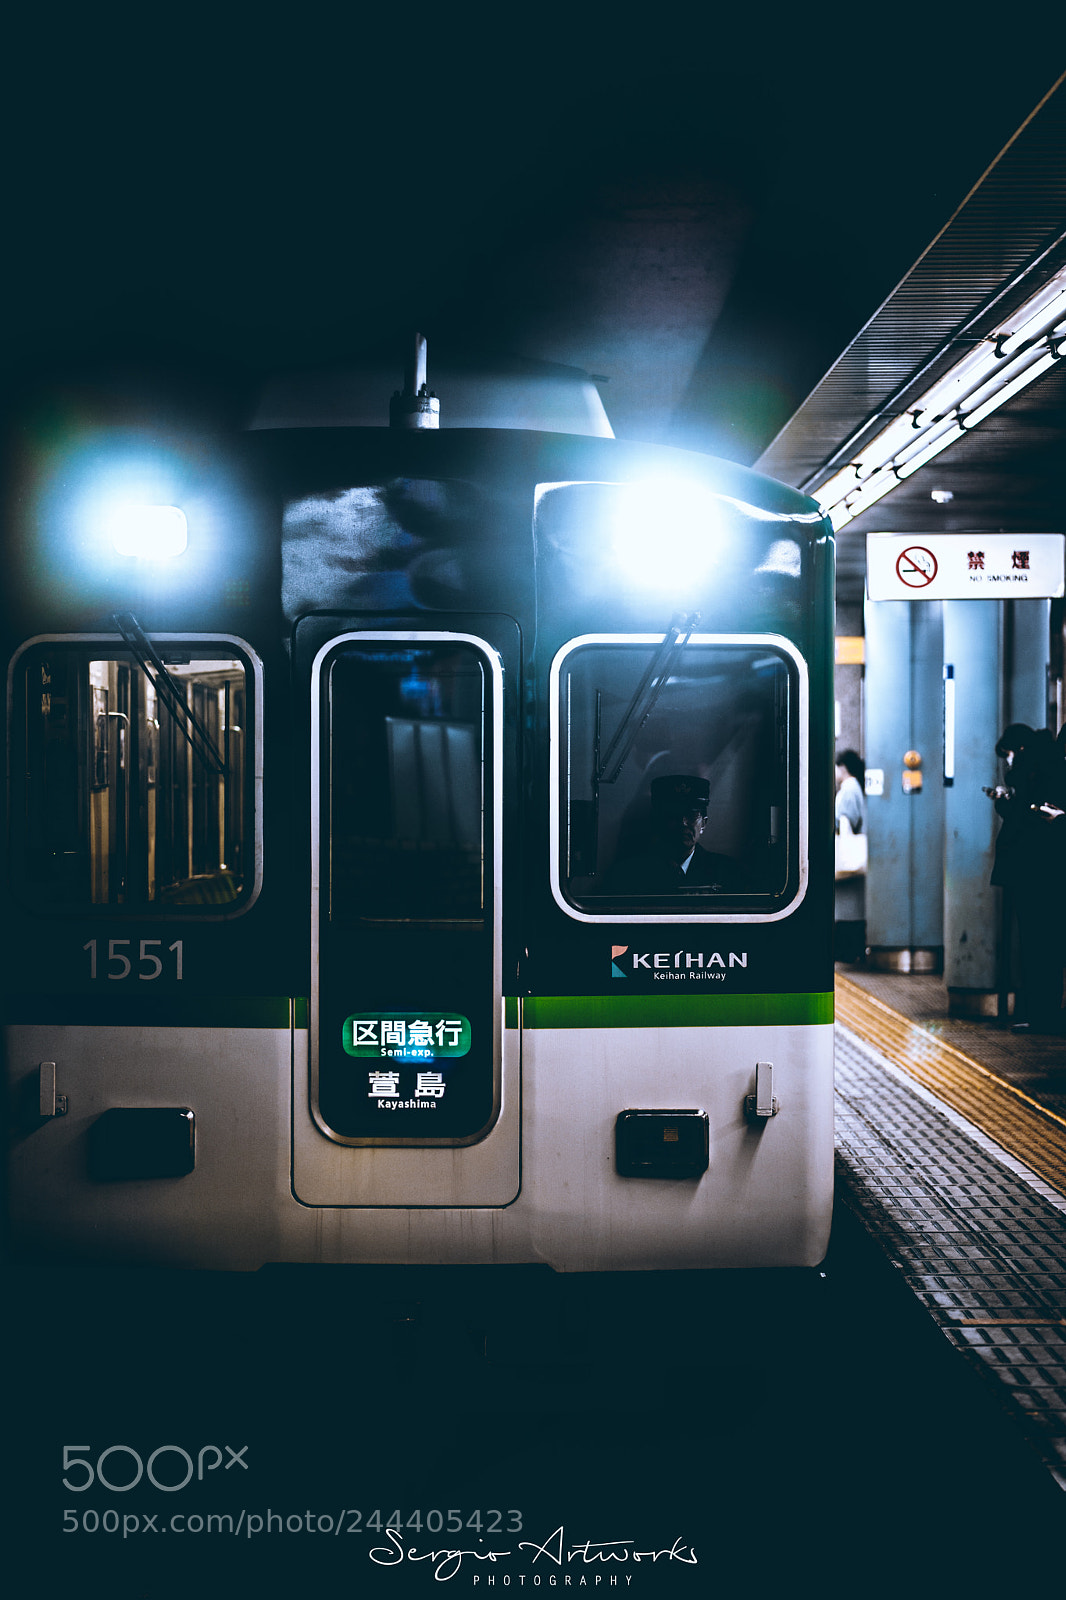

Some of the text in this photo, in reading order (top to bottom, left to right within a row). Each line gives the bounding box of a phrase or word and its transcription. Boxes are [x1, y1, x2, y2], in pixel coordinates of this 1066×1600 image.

[967, 550, 1030, 570] 禁煙
[988, 574, 1028, 582] SMOKING
[82, 939, 183, 980] 1551
[632, 950, 748, 969] KEIHAN
[653, 971, 726, 981] Keihan Railway
[352, 1019, 463, 1047] 区間急行
[380, 1048, 434, 1058] Semi-exp.
[368, 1071, 446, 1098] 萱島
[377, 1099, 436, 1110] Kayashima
